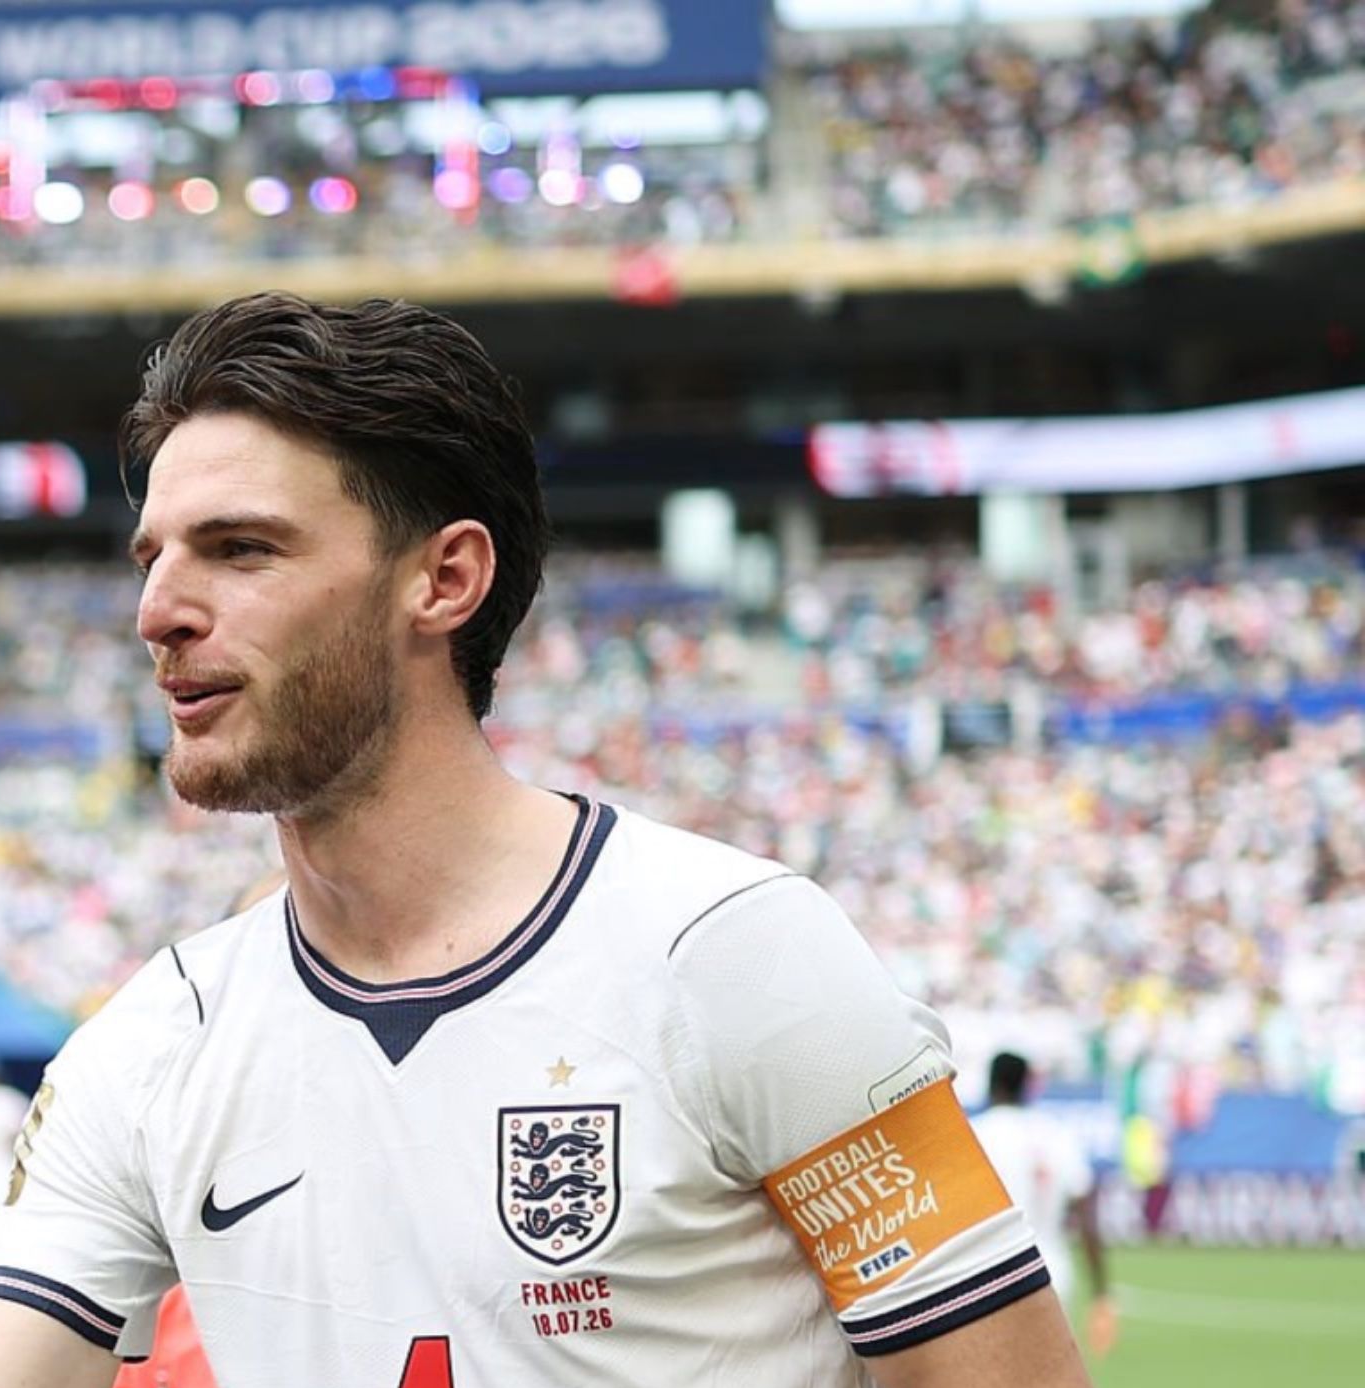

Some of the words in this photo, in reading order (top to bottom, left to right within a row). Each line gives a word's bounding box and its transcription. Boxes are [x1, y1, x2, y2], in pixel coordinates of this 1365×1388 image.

[777, 1129, 896, 1207] FOOTBALL
[792, 1153, 916, 1237] UNITES
[814, 1237, 851, 1271] the
[851, 1181, 938, 1250] World
[859, 1246, 911, 1279] FIFA
[521, 1276, 611, 1306] FRANCE
[532, 1308, 613, 1337] 18.07.26
